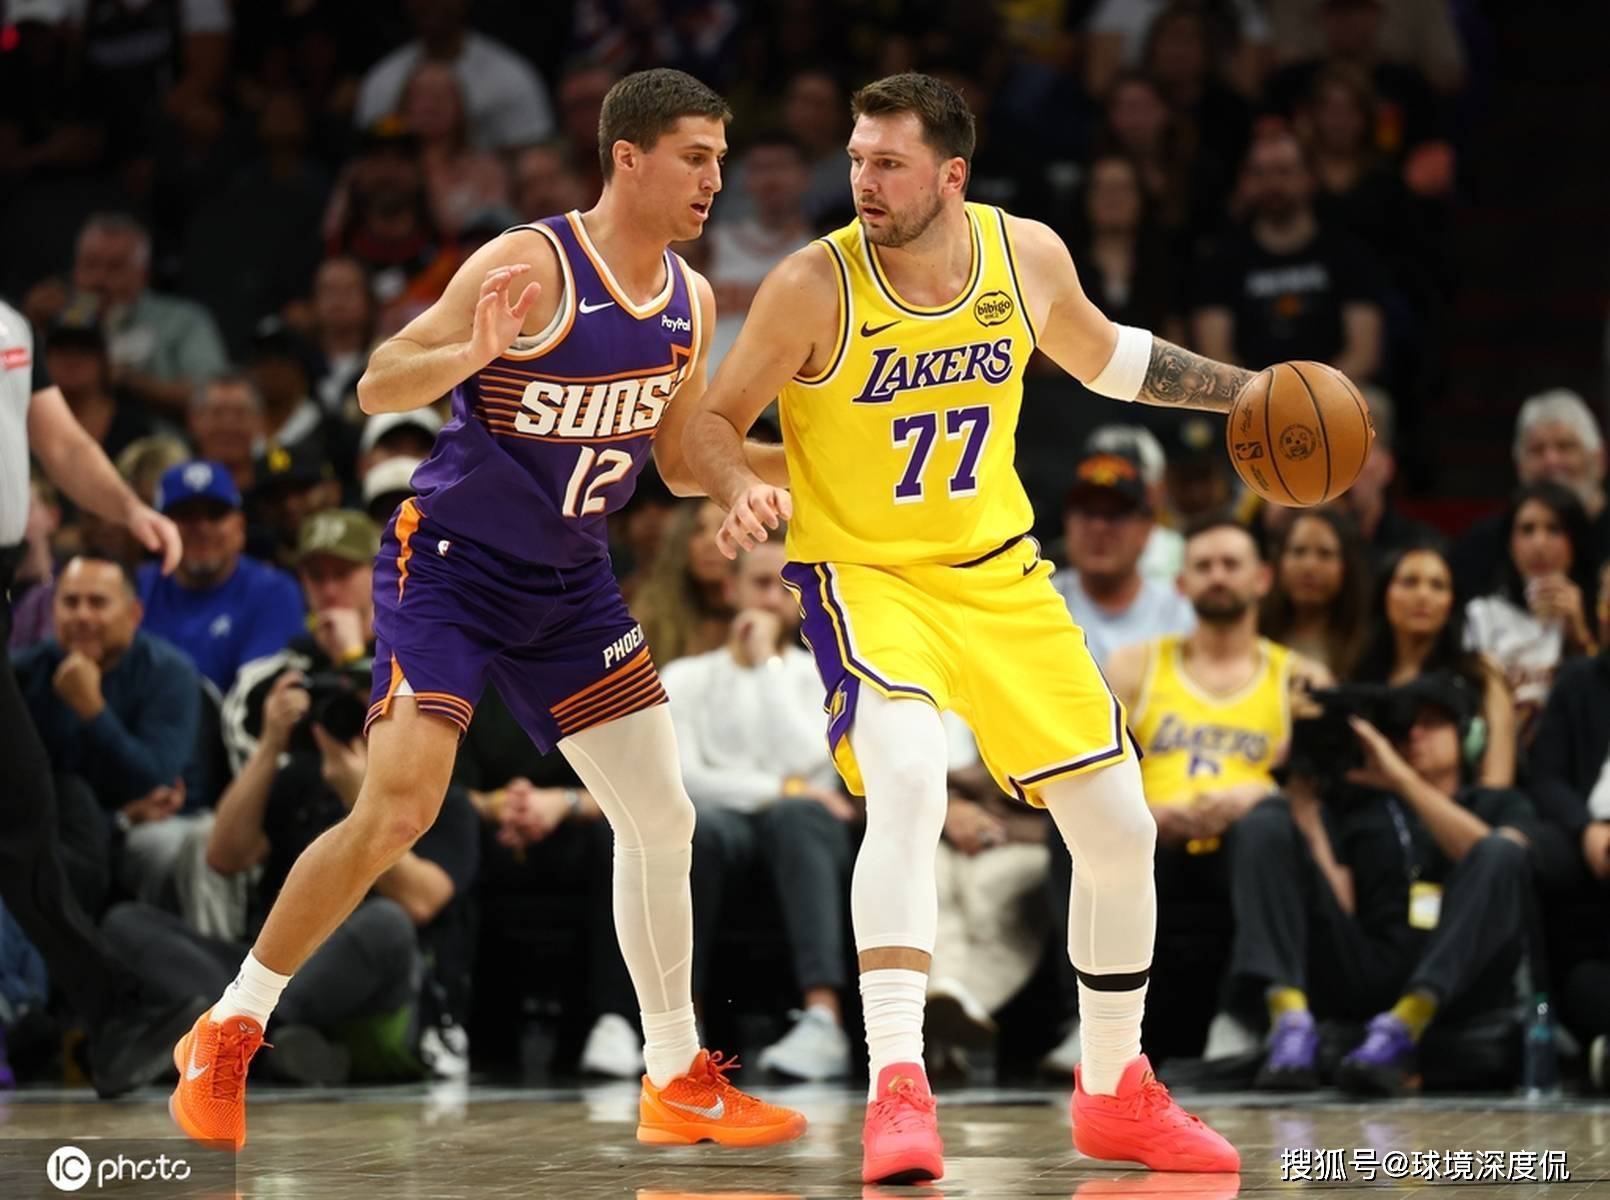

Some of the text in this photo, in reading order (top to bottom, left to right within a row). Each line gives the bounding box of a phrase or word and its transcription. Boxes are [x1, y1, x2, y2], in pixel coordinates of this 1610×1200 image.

[661, 313, 691, 333] PayPal
[977, 299, 1011, 316] bibigo
[852, 338, 1013, 404] LAKERS
[514, 375, 673, 438] SUNS
[562, 445, 634, 518] 12
[892, 405, 992, 505] 77
